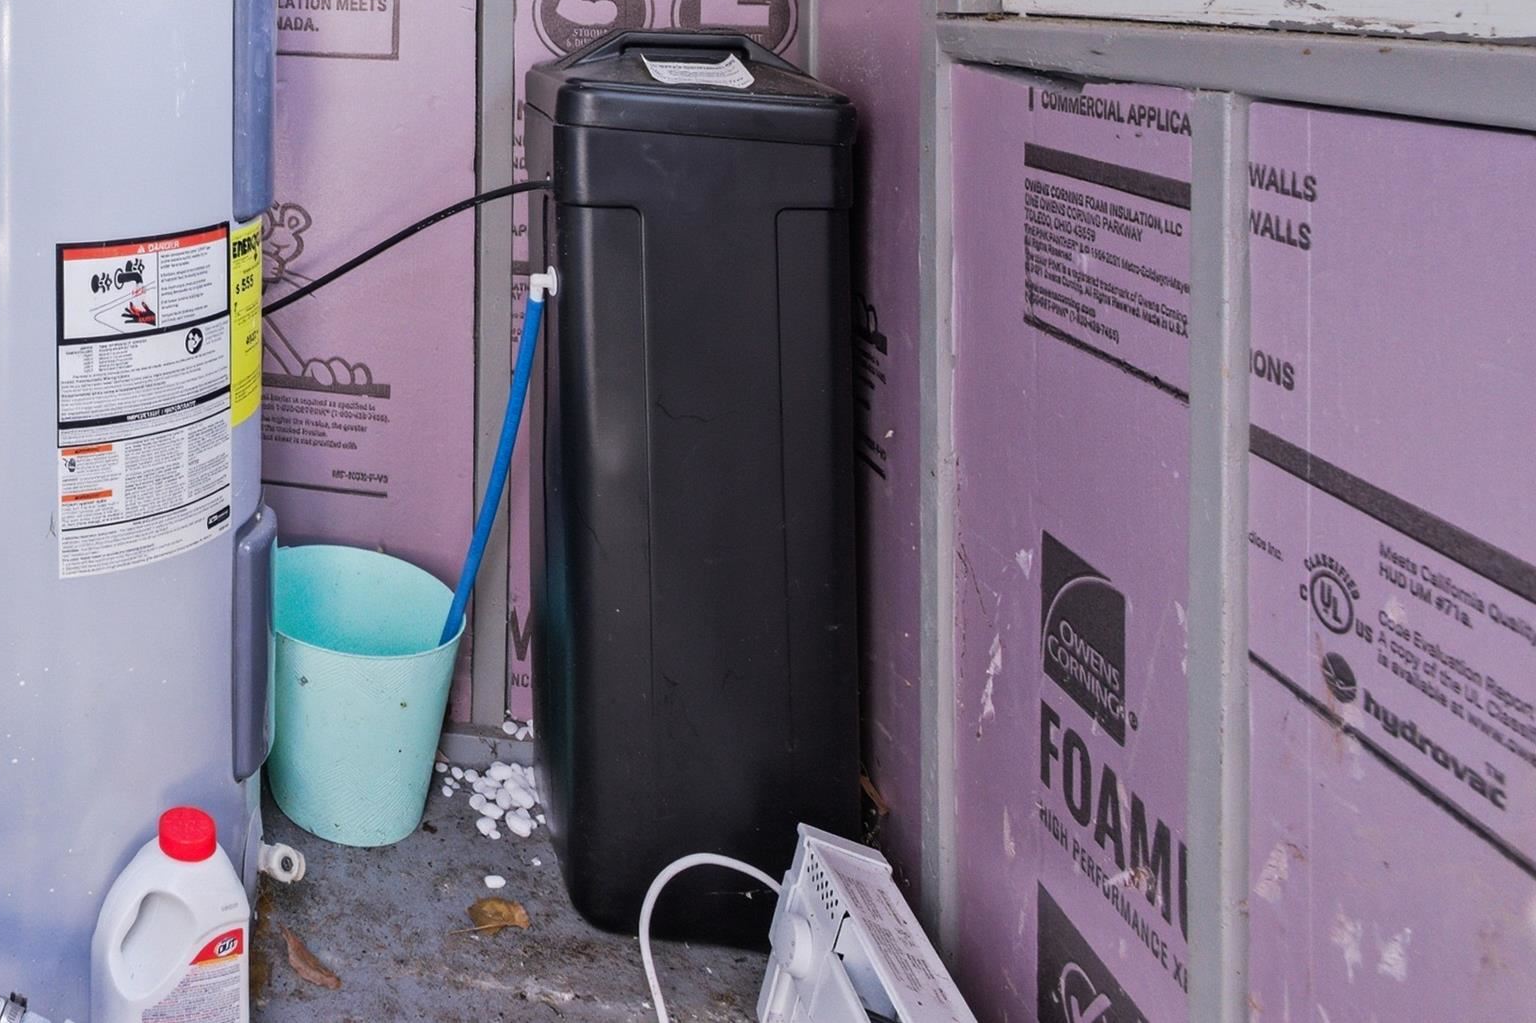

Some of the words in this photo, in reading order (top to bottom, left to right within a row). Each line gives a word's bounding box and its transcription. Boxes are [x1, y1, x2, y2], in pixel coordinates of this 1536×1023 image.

[1041, 89, 1125, 124] COMMERCIAL
[1127, 103, 1192, 136] APPLICA
[1024, 178, 1050, 196] OWENS
[1050, 185, 1084, 207] CORNING
[1085, 195, 1109, 213] FOAM
[1109, 202, 1164, 235] INSULATION,
[1164, 220, 1183, 237] LLC
[1102, 215, 1143, 242] PARKWAY
[147, 240, 180, 252] DANGER
[1138, 294, 1160, 313] Owens
[1303, 553, 1361, 601] CLASSIFIED
[1379, 561, 1407, 589] HUD
[1380, 540, 1418, 576] Meets
[1421, 564, 1486, 615] California
[1319, 580, 1343, 625] UL
[1355, 618, 1373, 644] US
[1059, 619, 1121, 690] OWENS
[1390, 640, 1419, 670] copy
[1414, 631, 1483, 686] Evaluation
[1363, 687, 1507, 811] hydrovac
[1039, 805, 1069, 850] HIGH
[1072, 833, 1169, 971] PERFORMANCE
